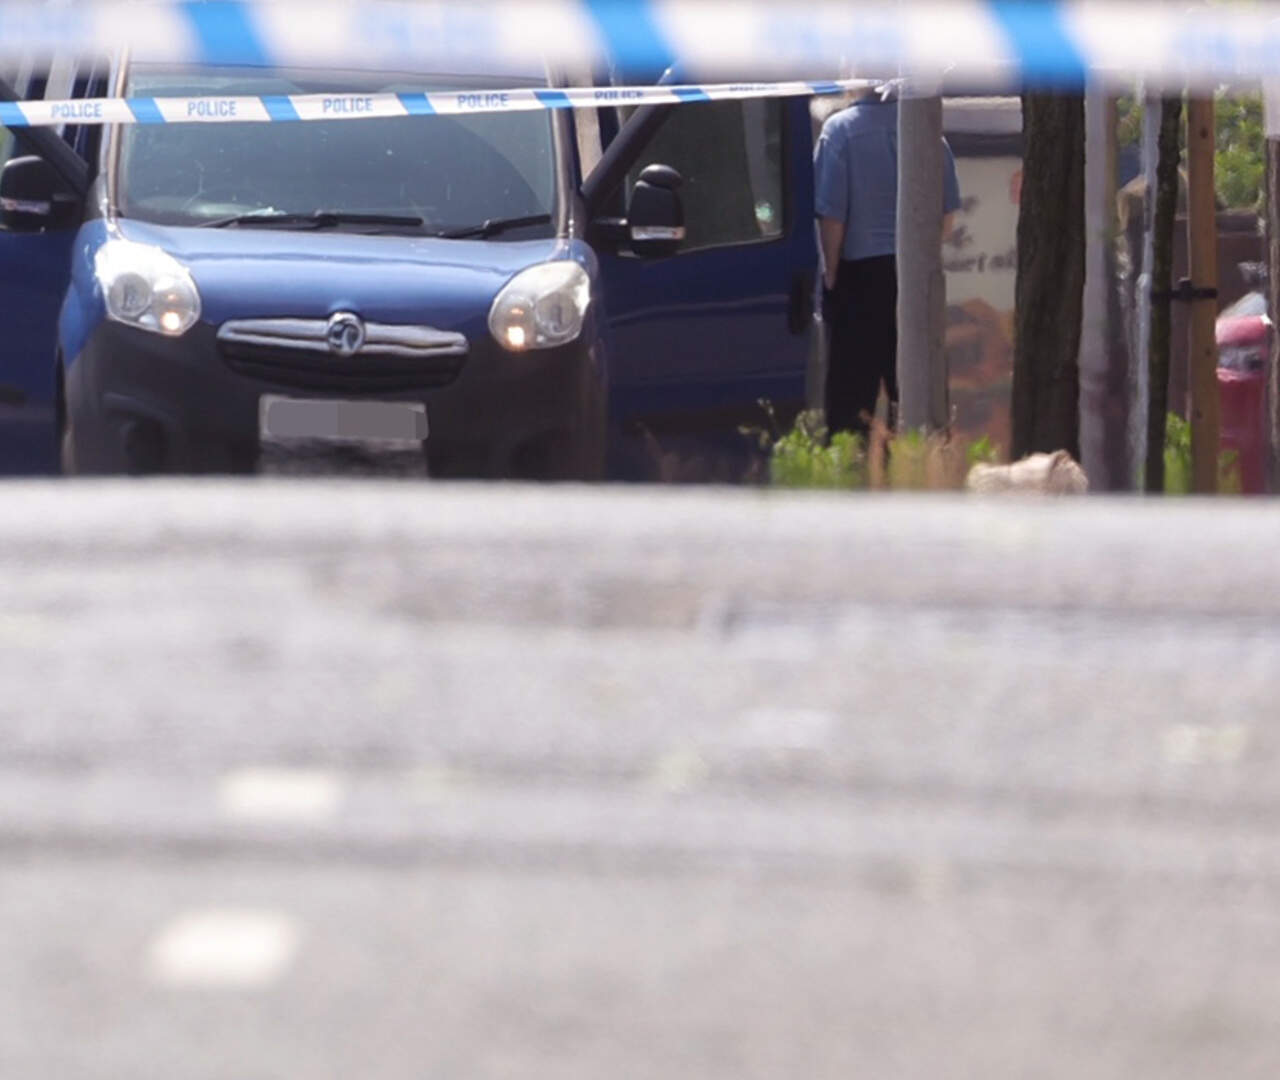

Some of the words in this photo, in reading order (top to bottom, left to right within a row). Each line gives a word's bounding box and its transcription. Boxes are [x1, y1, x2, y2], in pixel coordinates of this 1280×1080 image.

[187, 99, 237, 117] POLICE
[322, 97, 374, 113] POLICE
[457, 92, 509, 109] POLICE
[51, 101, 103, 119] POLICE
